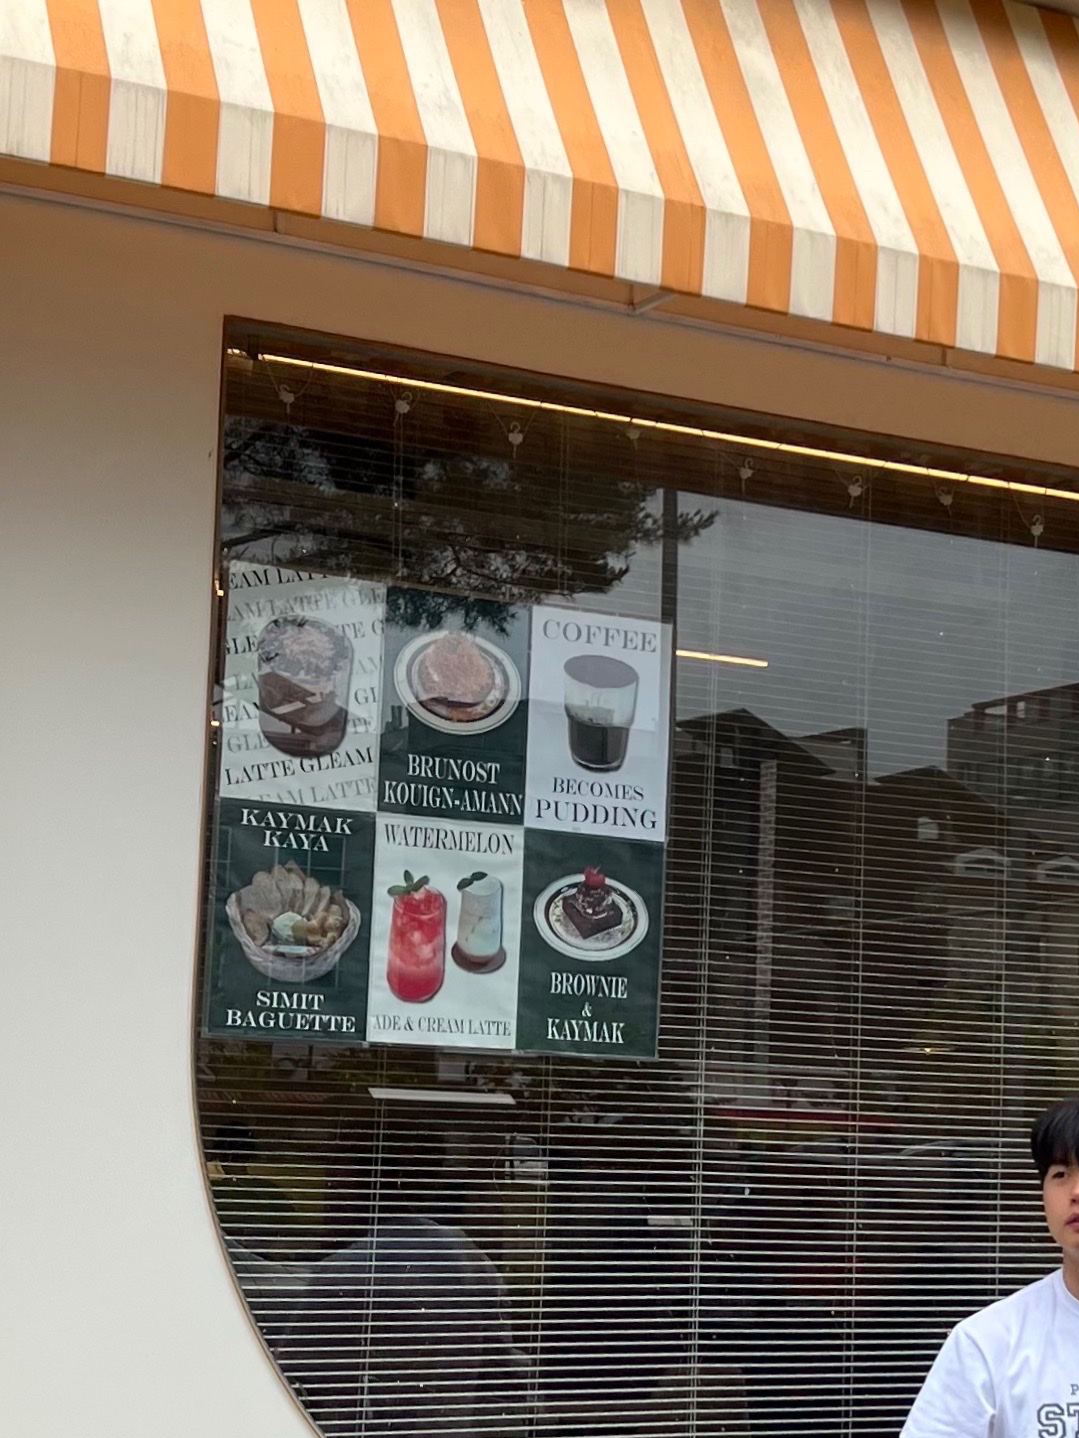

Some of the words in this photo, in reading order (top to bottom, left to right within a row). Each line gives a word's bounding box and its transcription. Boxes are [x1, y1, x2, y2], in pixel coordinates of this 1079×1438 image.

[542, 618, 657, 653] COFFEE
[224, 758, 296, 786] LATTE
[299, 746, 374, 774] GLEAM
[406, 753, 501, 784] BRUNOST
[383, 780, 523, 816] KOUIGN-AMANN
[552, 776, 645, 802] BECOMES
[240, 807, 353, 835] KAYMAK
[535, 798, 658, 830] PUDDING
[262, 829, 330, 852] KAYA
[384, 823, 516, 856] WATERMELON
[255, 989, 325, 1010] SIMIT
[550, 971, 629, 1000] BROWNIE
[225, 1008, 356, 1033] BAGUETTE
[580, 1001, 592, 1018] &
[372, 1014, 401, 1032] ADE
[403, 1016, 415, 1032] &
[417, 1016, 466, 1035] CREAM
[467, 1018, 512, 1037] LATTE
[546, 1017, 625, 1045] KAYMAK
